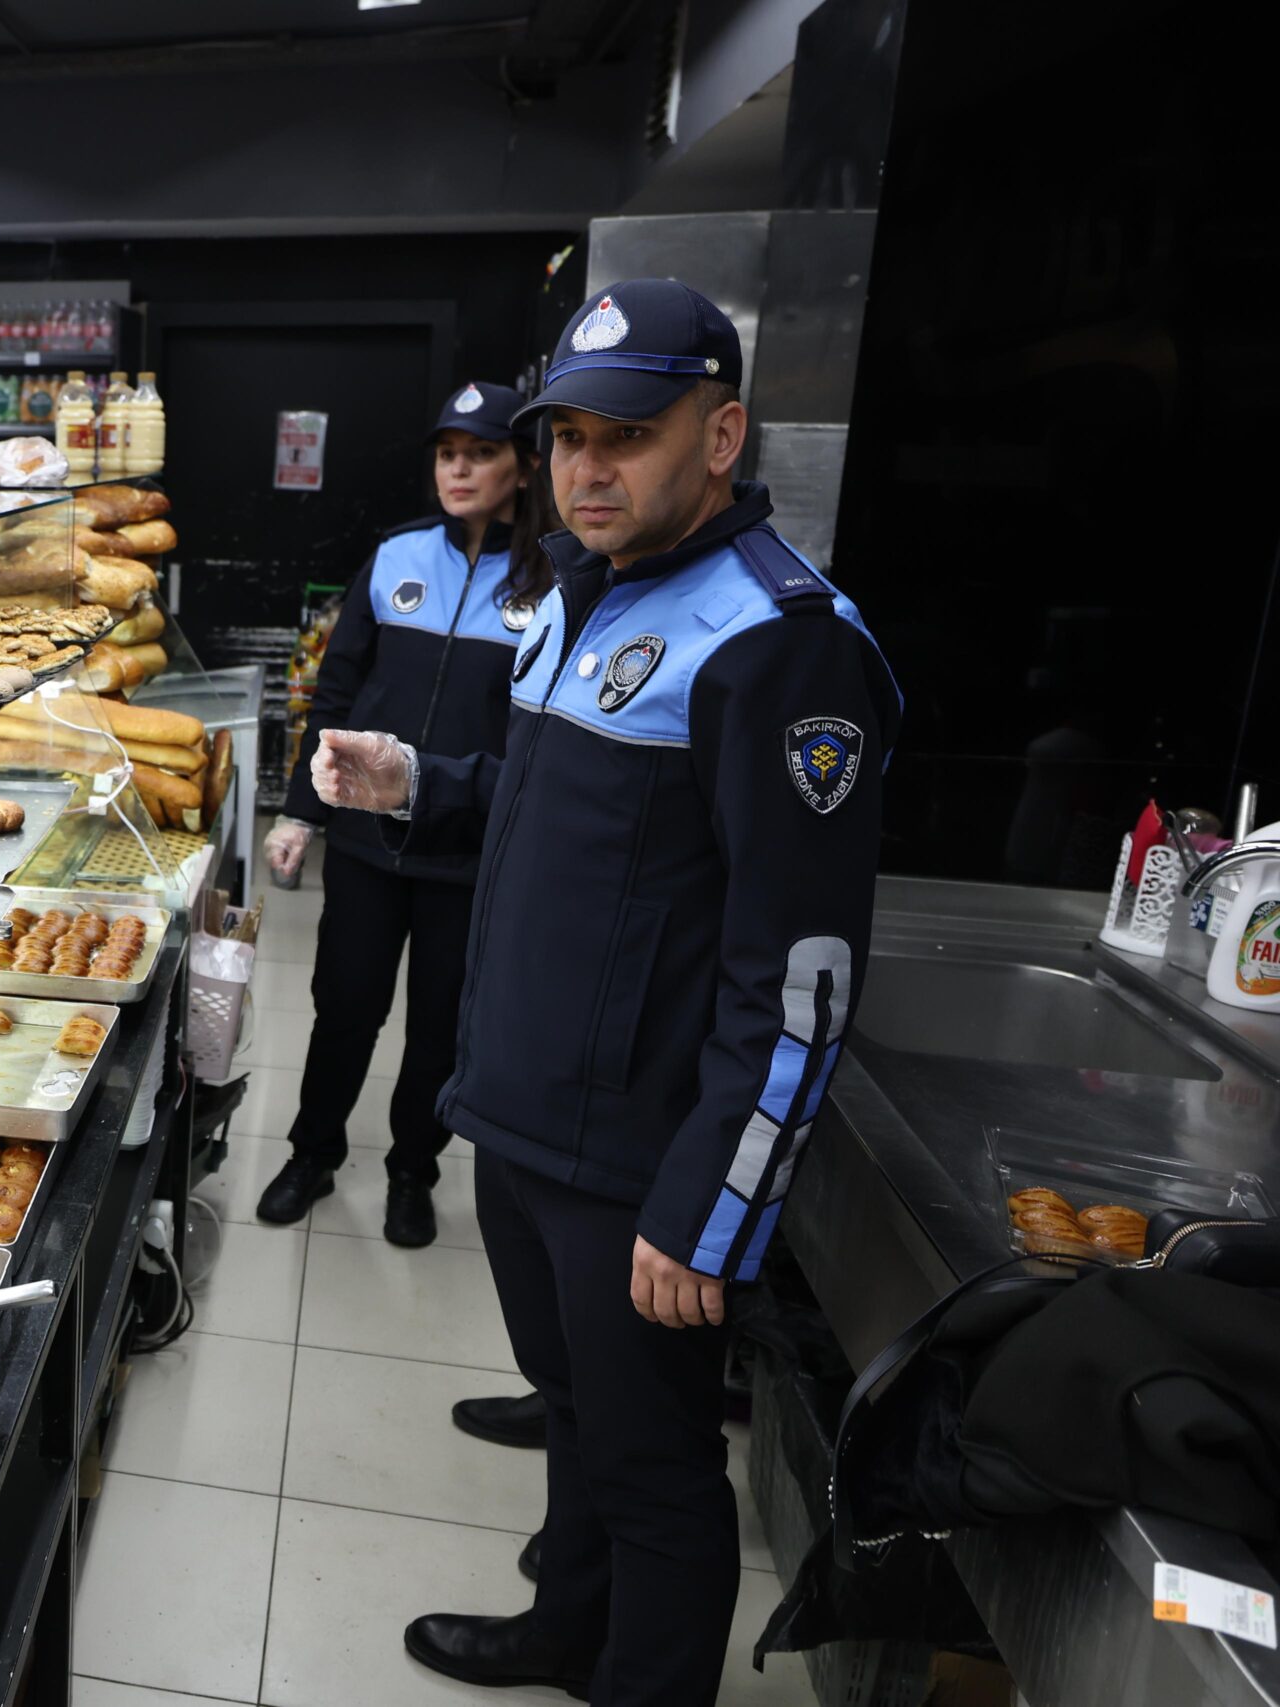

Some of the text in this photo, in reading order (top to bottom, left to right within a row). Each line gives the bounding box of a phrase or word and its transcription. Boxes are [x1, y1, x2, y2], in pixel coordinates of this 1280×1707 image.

[784, 577, 815, 587] 602
[793, 722, 857, 740] BAKIRKÖY
[824, 754, 858, 807] ZABITASI
[1251, 939, 1280, 963] FAI
